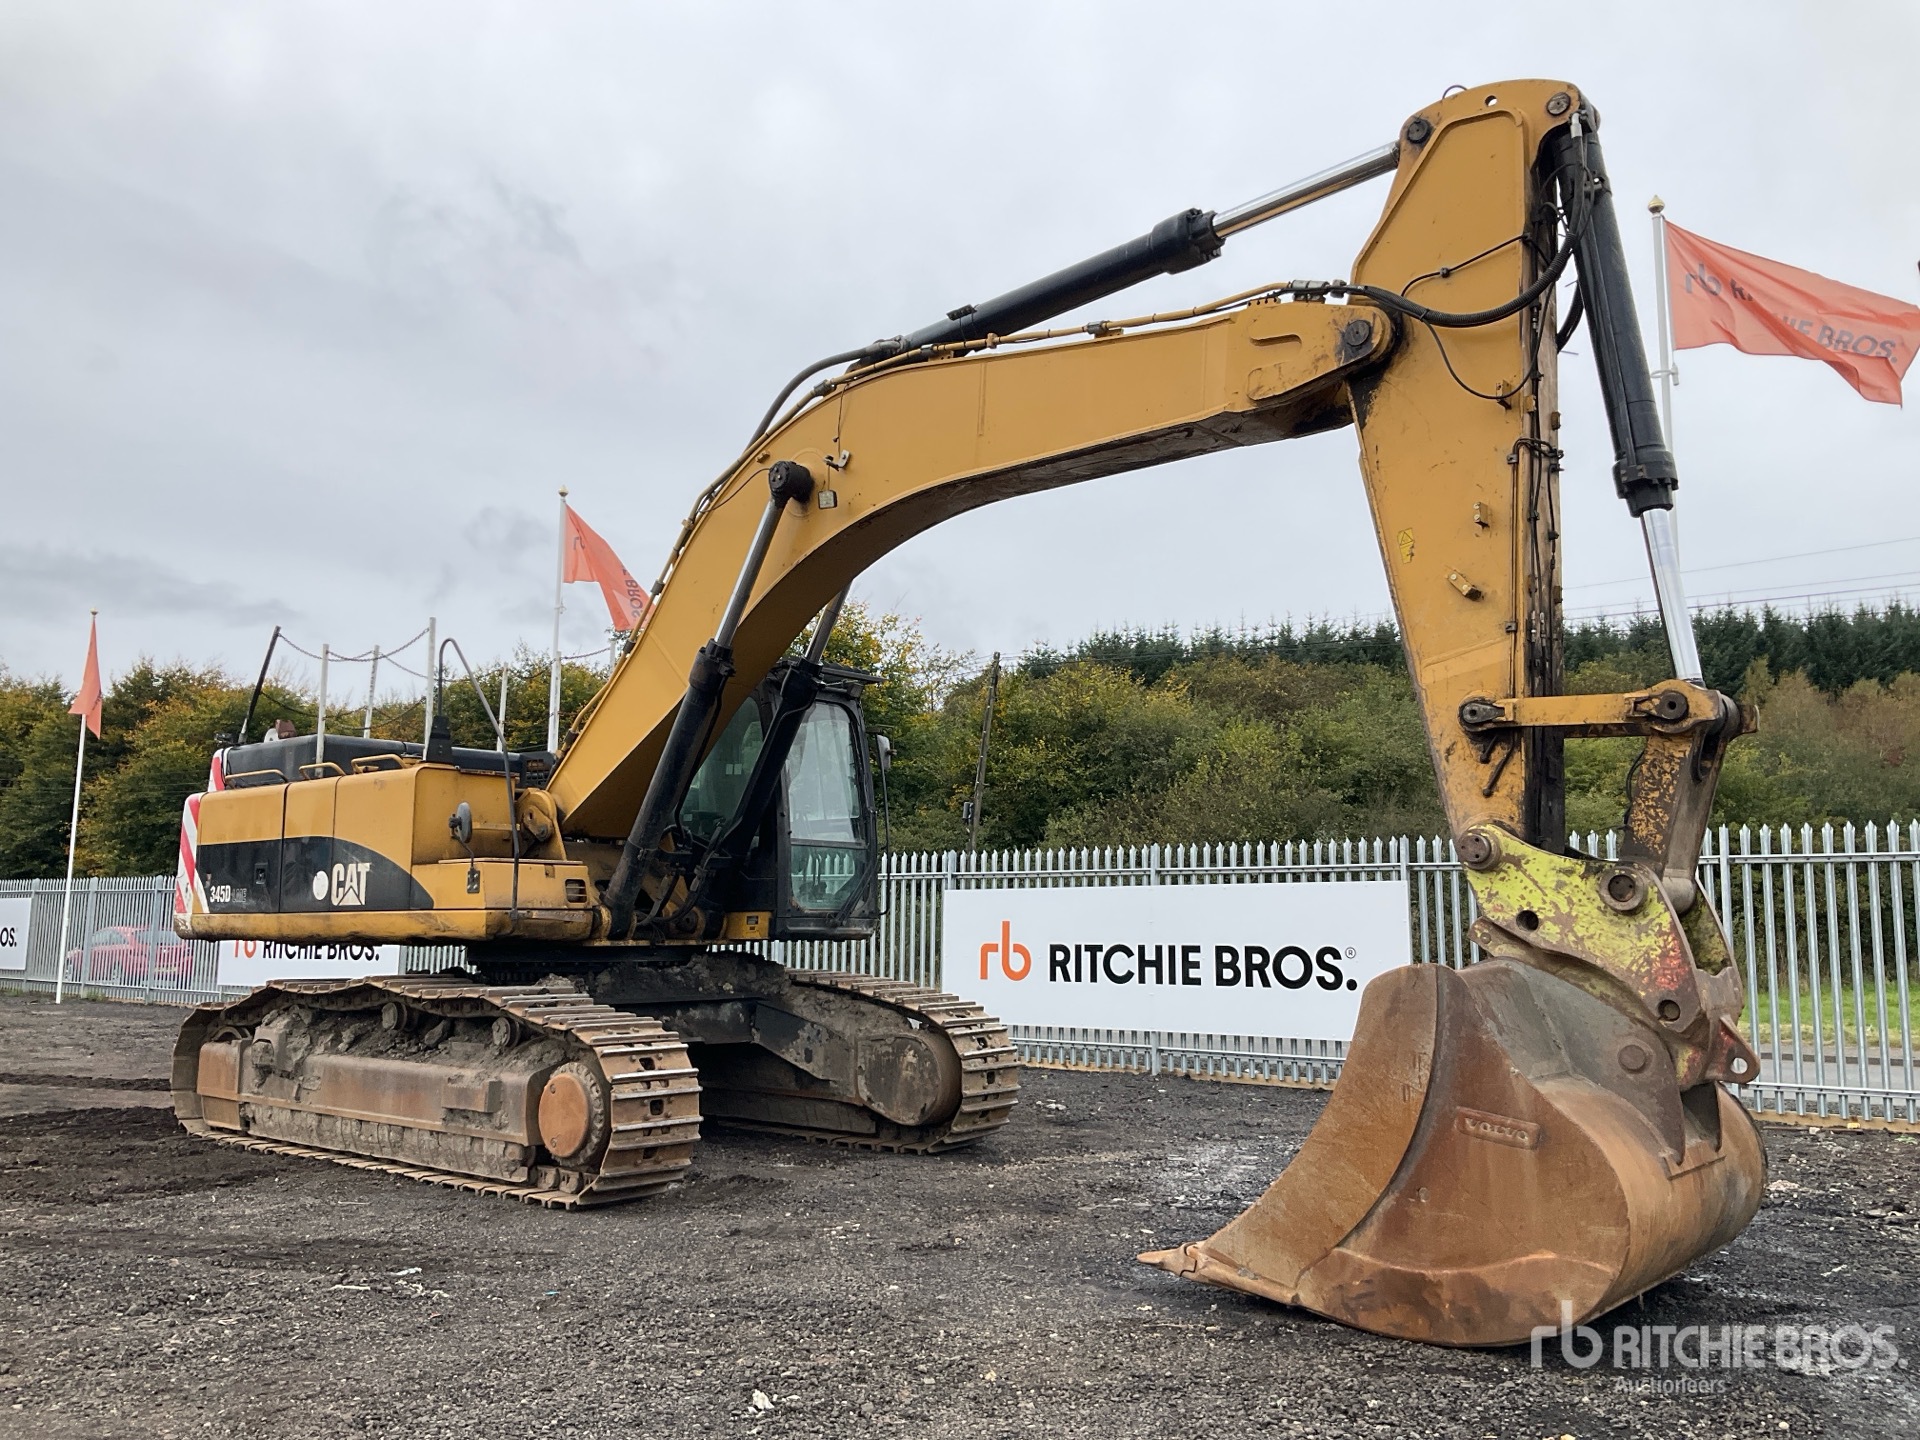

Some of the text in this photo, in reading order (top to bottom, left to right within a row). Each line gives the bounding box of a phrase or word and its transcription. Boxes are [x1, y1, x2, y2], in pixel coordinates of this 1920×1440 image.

[209, 885, 231, 903] 345D
[331, 862, 373, 906] CAT
[1049, 943, 1202, 986] RITCHIE
[1464, 1117, 1529, 1142] VOLVO
